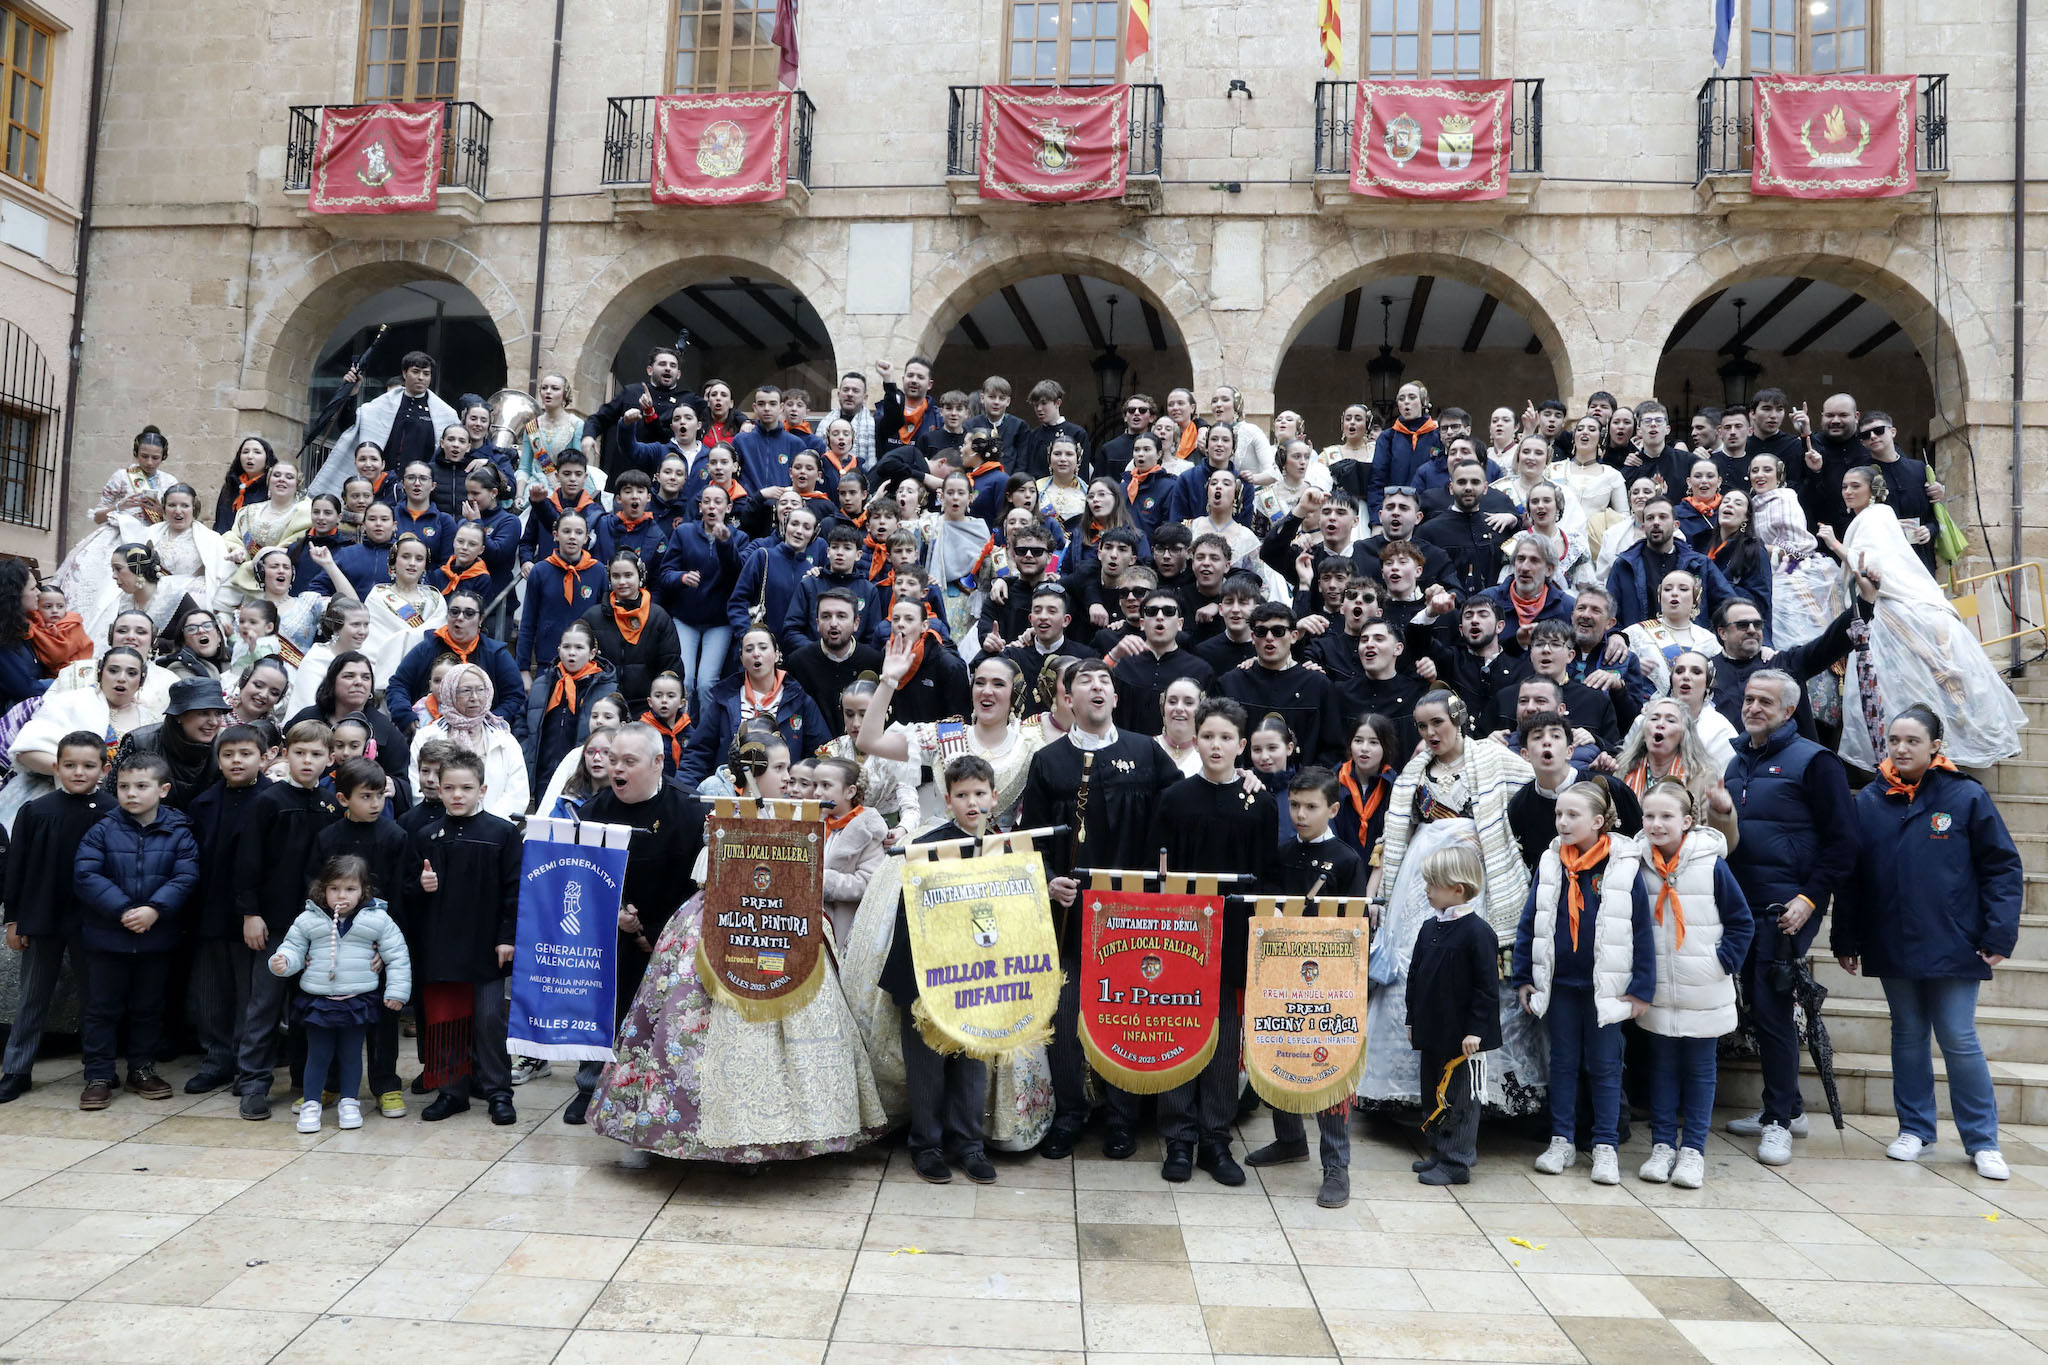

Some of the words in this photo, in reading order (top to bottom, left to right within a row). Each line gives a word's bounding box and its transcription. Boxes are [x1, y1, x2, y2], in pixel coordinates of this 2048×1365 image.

[722, 844, 745, 861] JUNTA
[747, 845, 770, 860] LOCAL
[772, 846, 809, 862] FALLERA
[527, 860, 557, 881] PREMI
[558, 857, 616, 889] GENERALITAT
[922, 884, 987, 909] AJUNTAMENT
[988, 881, 1002, 897] DE
[1003, 876, 1034, 896] DÉNIA
[1106, 917, 1159, 931] AJUNTAMENT
[1161, 920, 1172, 931] DE
[1173, 917, 1198, 932] DÉNIA
[535, 942, 603, 958] GENERALITAT
[1098, 939, 1129, 965] JUNTA
[1131, 937, 1161, 950] LOCAL
[1163, 937, 1205, 967] FALLERA
[1261, 942, 1289, 960] JUNTA
[1290, 942, 1318, 957] LOCAL
[1319, 942, 1354, 957] FALLERA
[535, 954, 601, 970] VALENCIANA
[725, 954, 756, 964] Patrocina:
[926, 960, 998, 988] MILLOR
[1003, 954, 1052, 976] FALLA
[529, 975, 551, 984] MILLOR
[552, 977, 571, 986] FALLA
[573, 979, 603, 989] INFANTIL
[726, 970, 749, 989] FALLES
[750, 983, 766, 991] 2025
[542, 985, 553, 993] DEL
[554, 987, 588, 995] MUNICIPI
[955, 981, 1033, 1010] INFANTIL
[1098, 978, 1125, 1003] 1r
[1131, 987, 1201, 1006] Premi
[1263, 989, 1288, 999] PREMI
[1291, 989, 1325, 999] MANUEL
[1328, 990, 1354, 999] MARCO
[529, 1016, 569, 1029] FALLES
[571, 1019, 597, 1031] 2025
[1098, 1013, 1141, 1026] SECCIÓ
[1145, 1016, 1201, 1028] ESPECIAL
[960, 1022, 991, 1038] FALLES
[1123, 1030, 1175, 1042] INFANTIL
[1256, 1035, 1284, 1044] SECCIÓ
[1287, 1036, 1322, 1044] ESPECIAL
[1325, 1036, 1356, 1044] INFANTIL
[1111, 1043, 1137, 1062] FALLES
[1276, 1050, 1312, 1058] Patrocina:
[1271, 1064, 1297, 1082] FALLES
[1297, 1075, 1313, 1084] 2025
